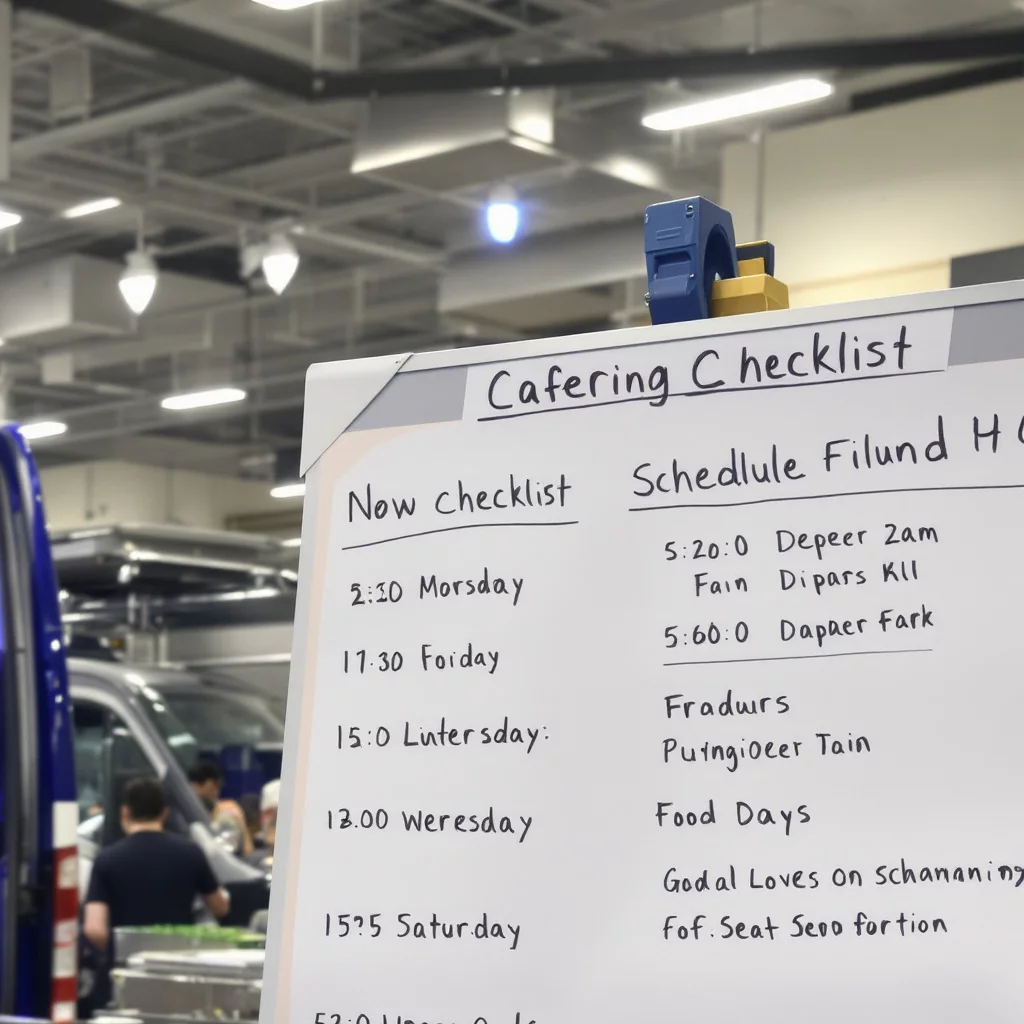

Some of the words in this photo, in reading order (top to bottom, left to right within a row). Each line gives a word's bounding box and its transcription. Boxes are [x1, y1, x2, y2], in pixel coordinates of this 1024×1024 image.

[348, 483, 416, 523] Now
[776, 528, 869, 562] Depeer
[419, 566, 525, 608] Morsday
[779, 567, 867, 596] Dipars
[337, 724, 391, 750] 15:0
[814, 731, 872, 757] Tain
[655, 799, 717, 827] Food
[735, 801, 812, 837] Days
